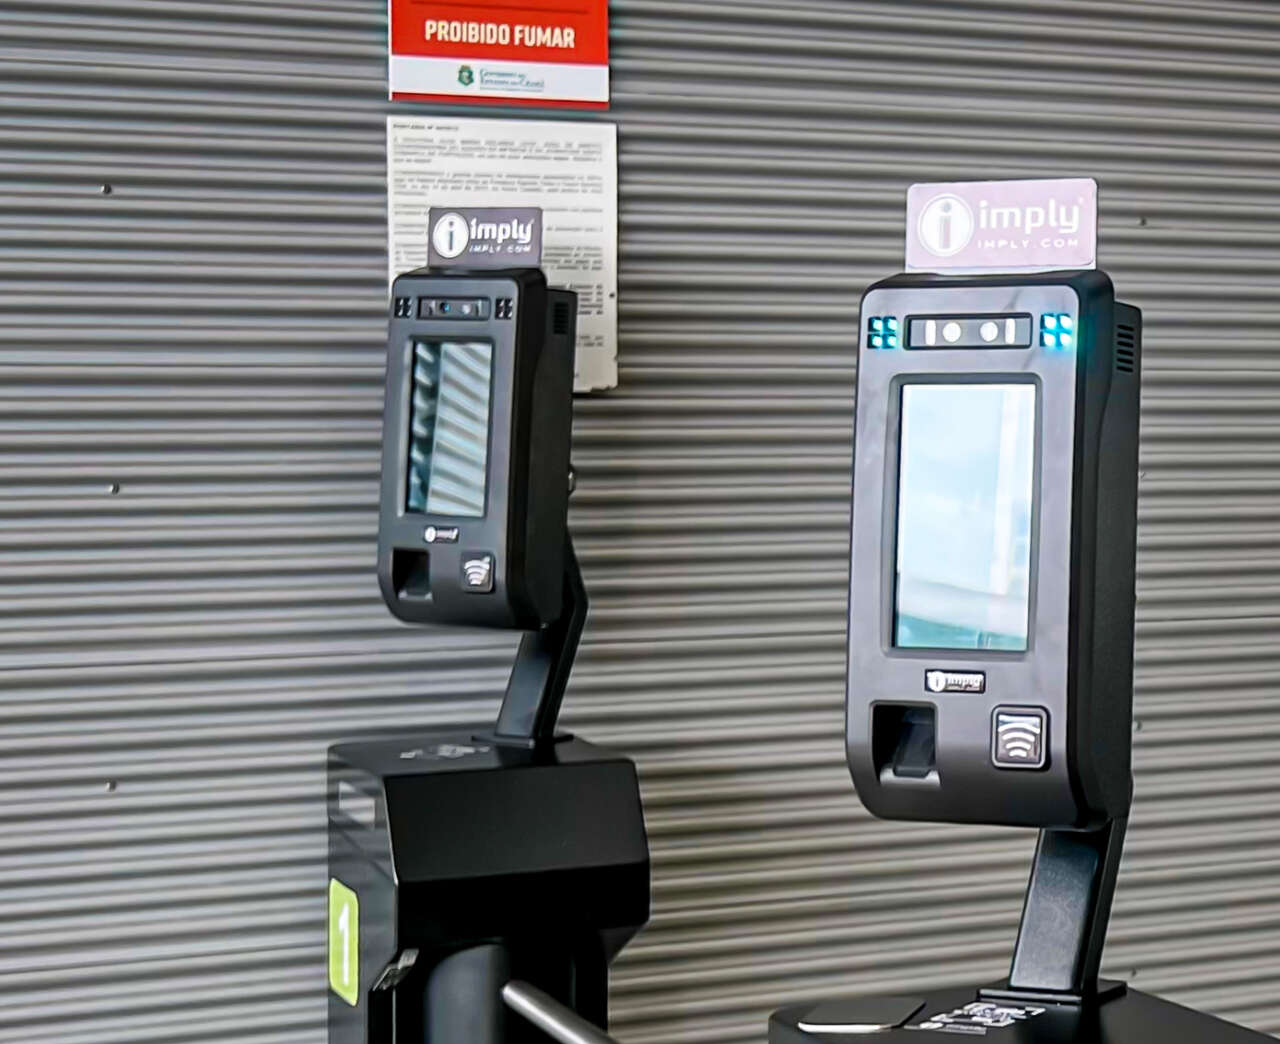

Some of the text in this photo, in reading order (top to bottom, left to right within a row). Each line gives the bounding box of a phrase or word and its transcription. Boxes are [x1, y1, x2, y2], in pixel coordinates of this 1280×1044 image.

[424, 19, 576, 49] PROIBIDO FUMAR
[470, 218, 533, 244] imply
[978, 198, 1080, 235] imply
[977, 238, 1080, 248] IMPLY.COM
[338, 902, 350, 987] 1
